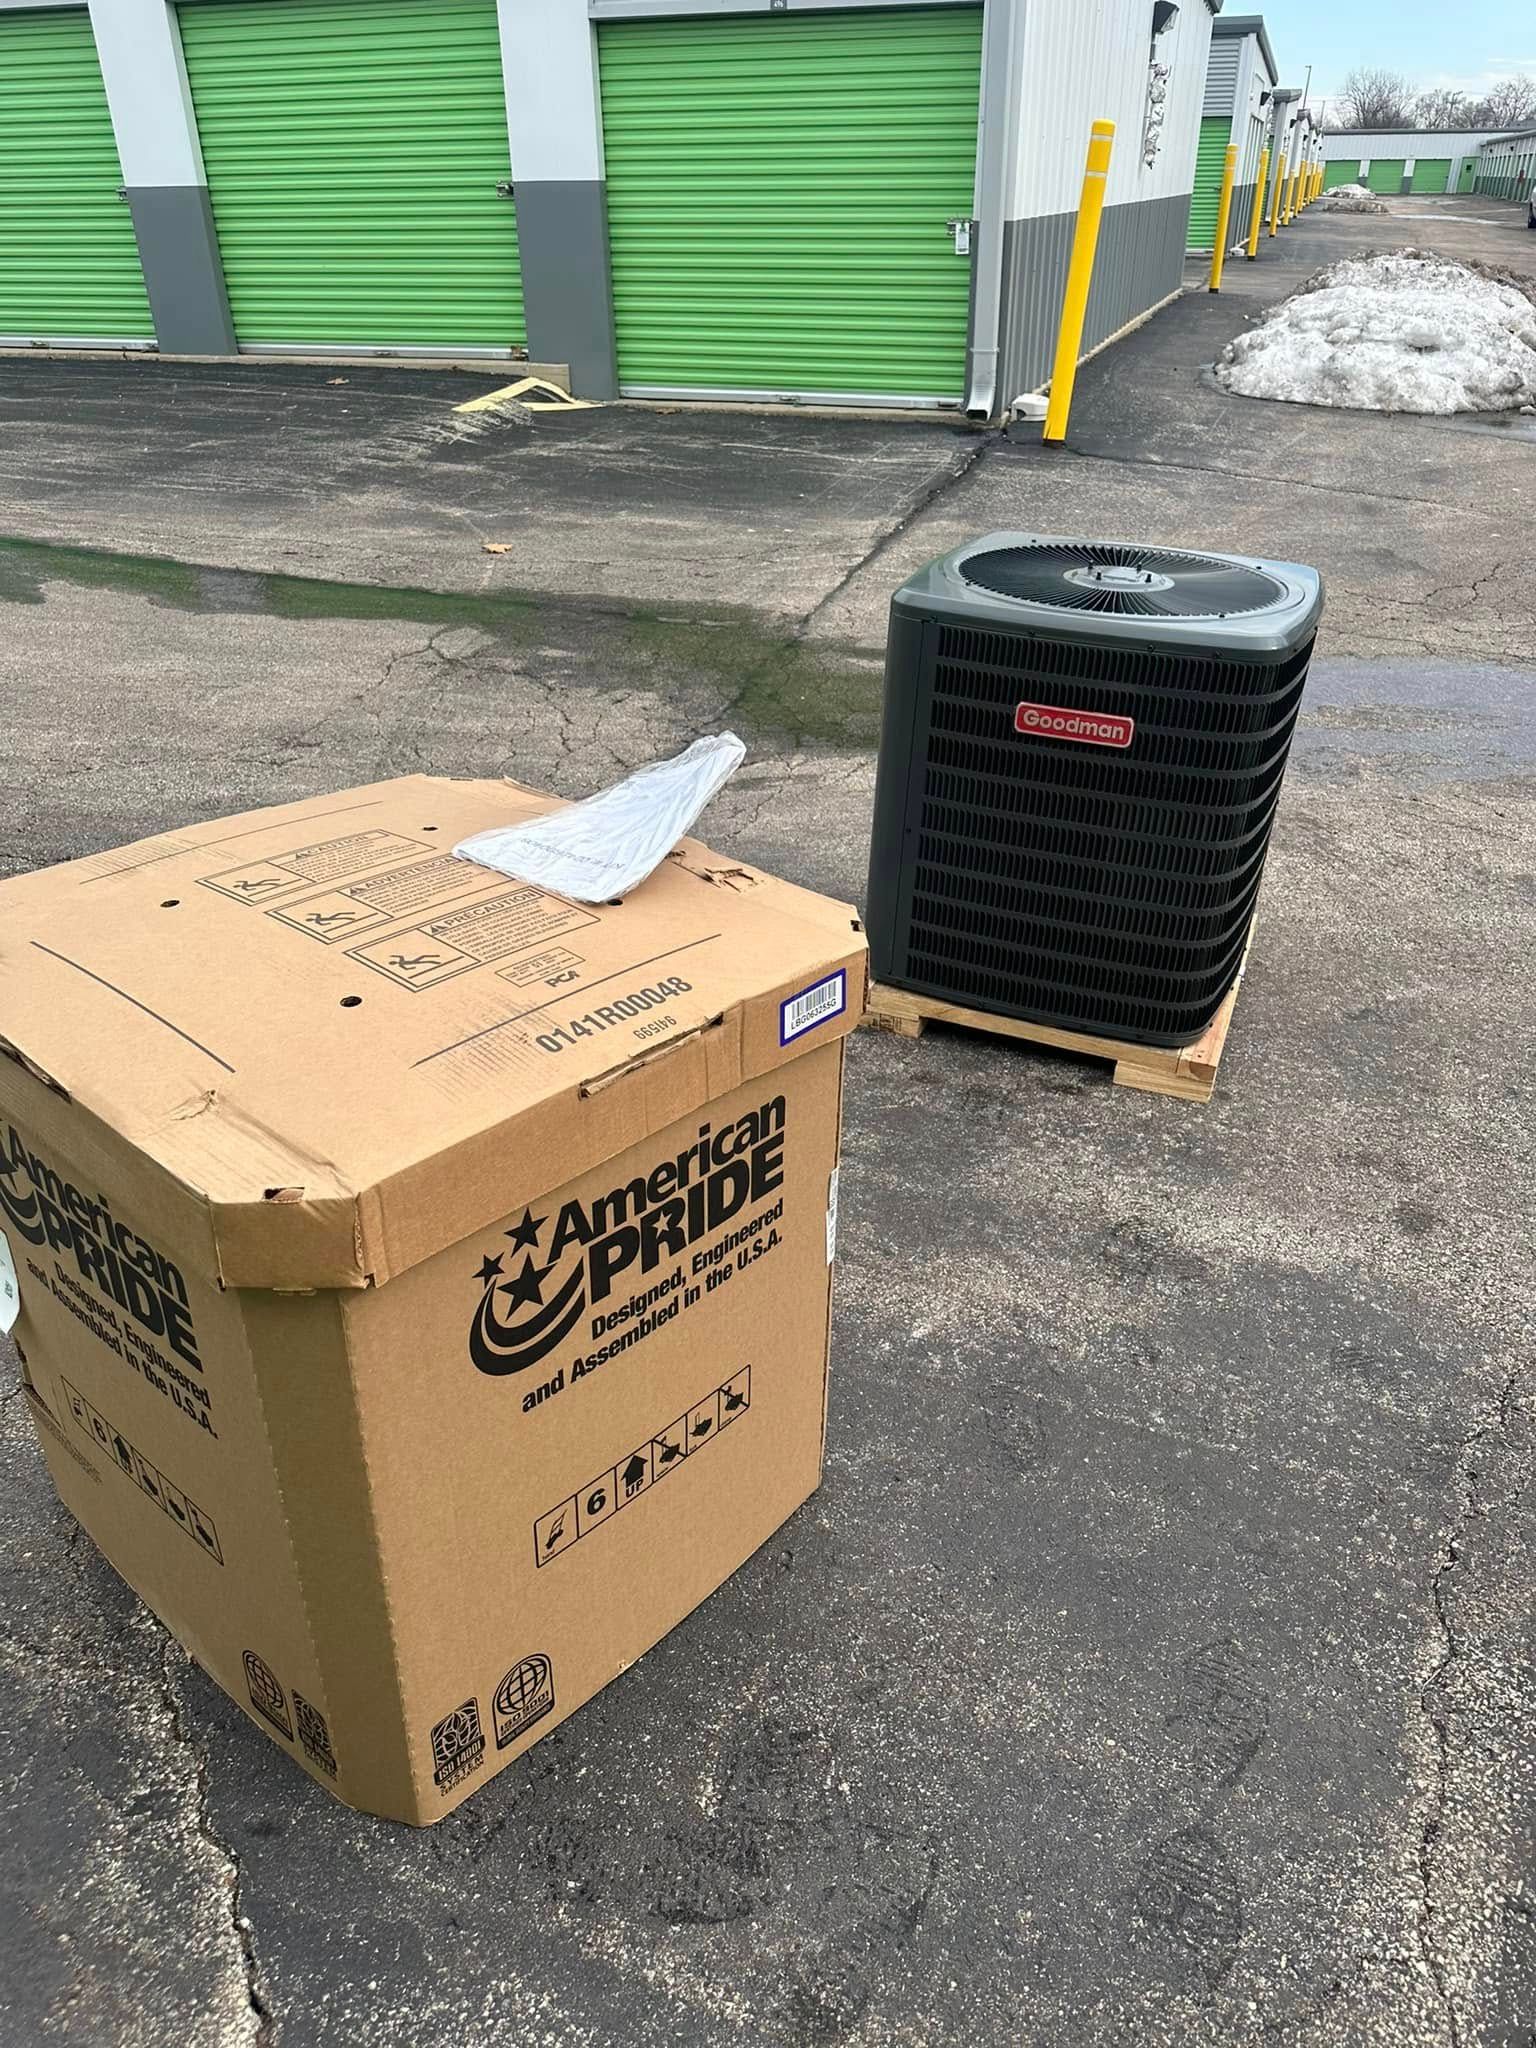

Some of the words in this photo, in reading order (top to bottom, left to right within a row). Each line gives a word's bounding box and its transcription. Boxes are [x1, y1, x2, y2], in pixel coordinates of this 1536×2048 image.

[1023, 709, 1125, 740] Goodman
[535, 976, 693, 1053] 0141R00048
[544, 970, 582, 988] PCA
[9, 1125, 190, 1309] American
[547, 1095, 786, 1265] American
[588, 1131, 785, 1305] PRIDE
[35, 1189, 203, 1374] PRIDE
[54, 1261, 124, 1338] Designed,
[123, 1321, 212, 1410] Engineered
[522, 1369, 565, 1413] and
[570, 1298, 679, 1384] Assembled
[684, 1286, 700, 1310] in
[705, 1267, 733, 1293] the
[737, 1232, 783, 1272] U.S.A.
[591, 1267, 687, 1341] Designed,
[692, 1198, 784, 1275] Engineered
[26, 1258, 50, 1290] and
[51, 1278, 122, 1362] Assembled
[123, 1346, 141, 1374] in
[142, 1361, 168, 1395] the
[169, 1383, 219, 1440] U.S.A.
[587, 1487, 606, 1516] 6
[625, 1478, 644, 1499] UP
[439, 1764, 456, 1780] ISO
